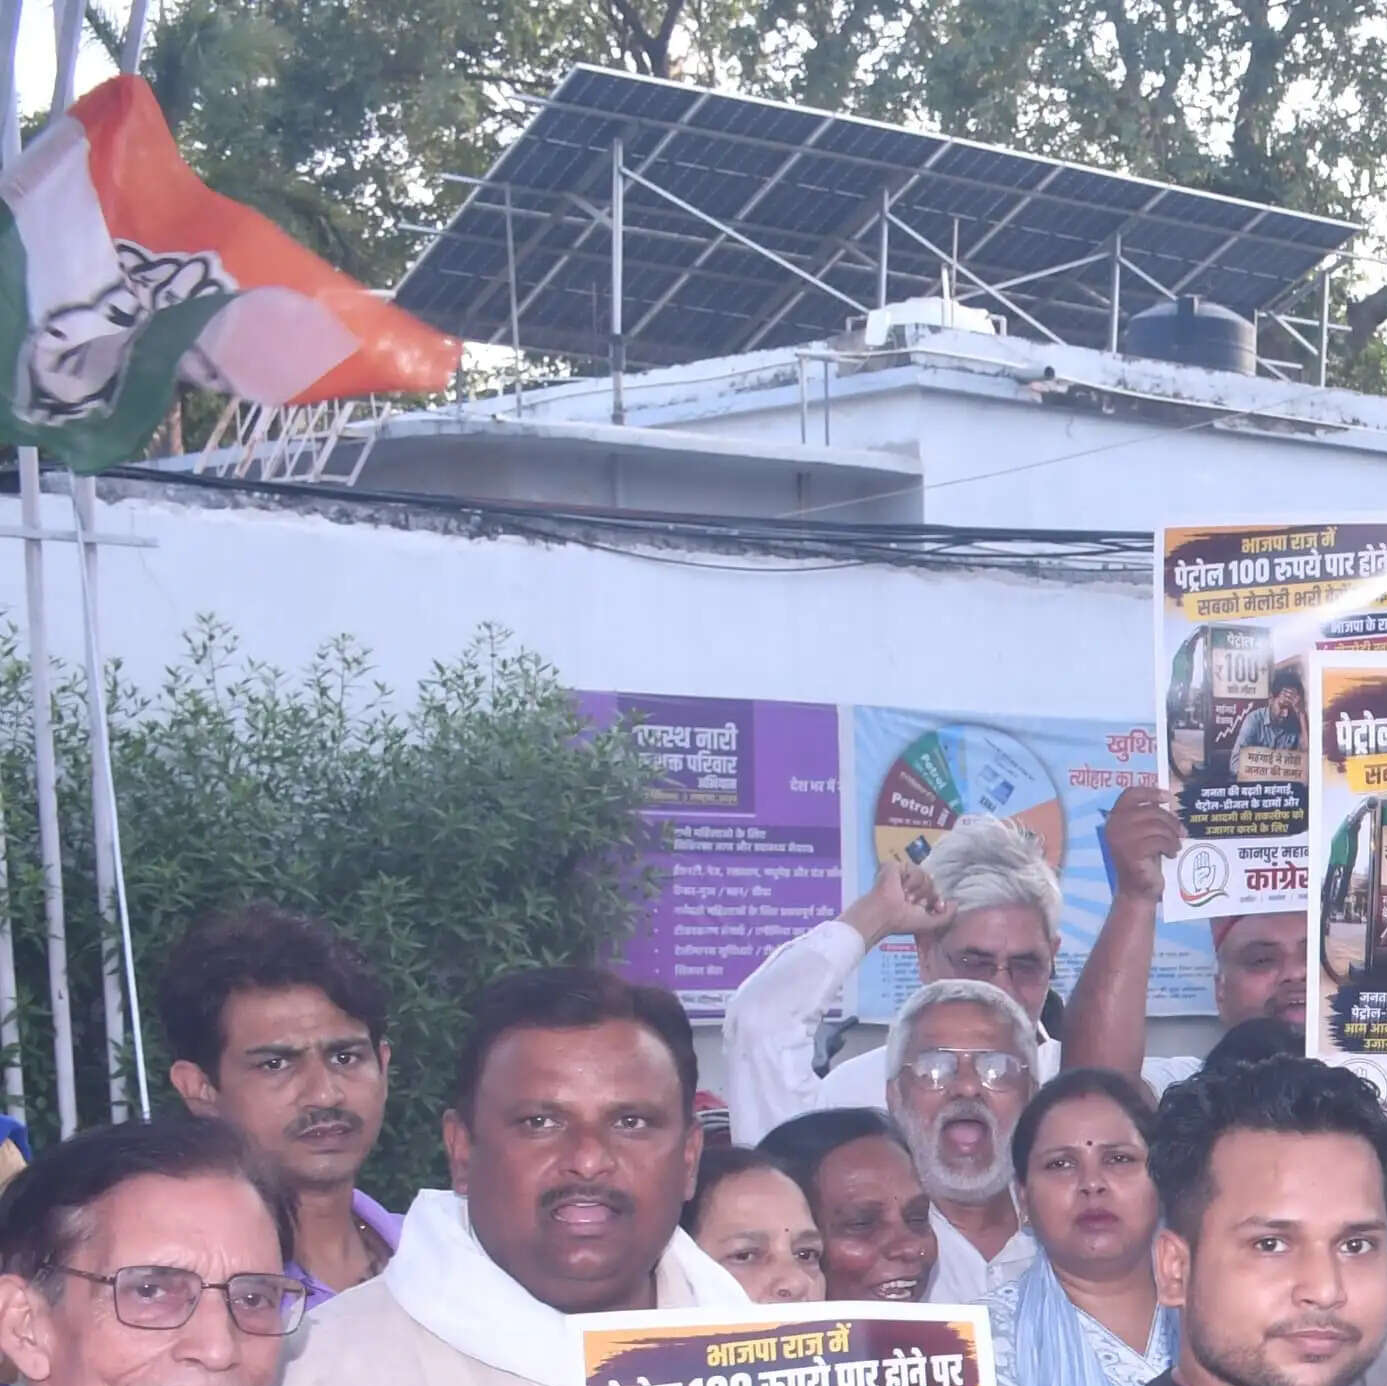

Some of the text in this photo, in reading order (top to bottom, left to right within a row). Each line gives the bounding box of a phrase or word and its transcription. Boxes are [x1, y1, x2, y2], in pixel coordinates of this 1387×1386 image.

[1241, 527, 1337, 553] भाजपा राज में
[1174, 558, 1226, 592] पेट्रोल
[1228, 558, 1269, 585] 100
[1274, 550, 1323, 579] रुपये
[1324, 552, 1356, 576] पार
[694, 722, 739, 751] नारी
[686, 750, 738, 773] परिवार
[921, 753, 946, 790] Petrol
[892, 792, 935, 817] Petrol
[707, 1323, 851, 1367] भाजपा राज में
[931, 1353, 963, 1386] पर
